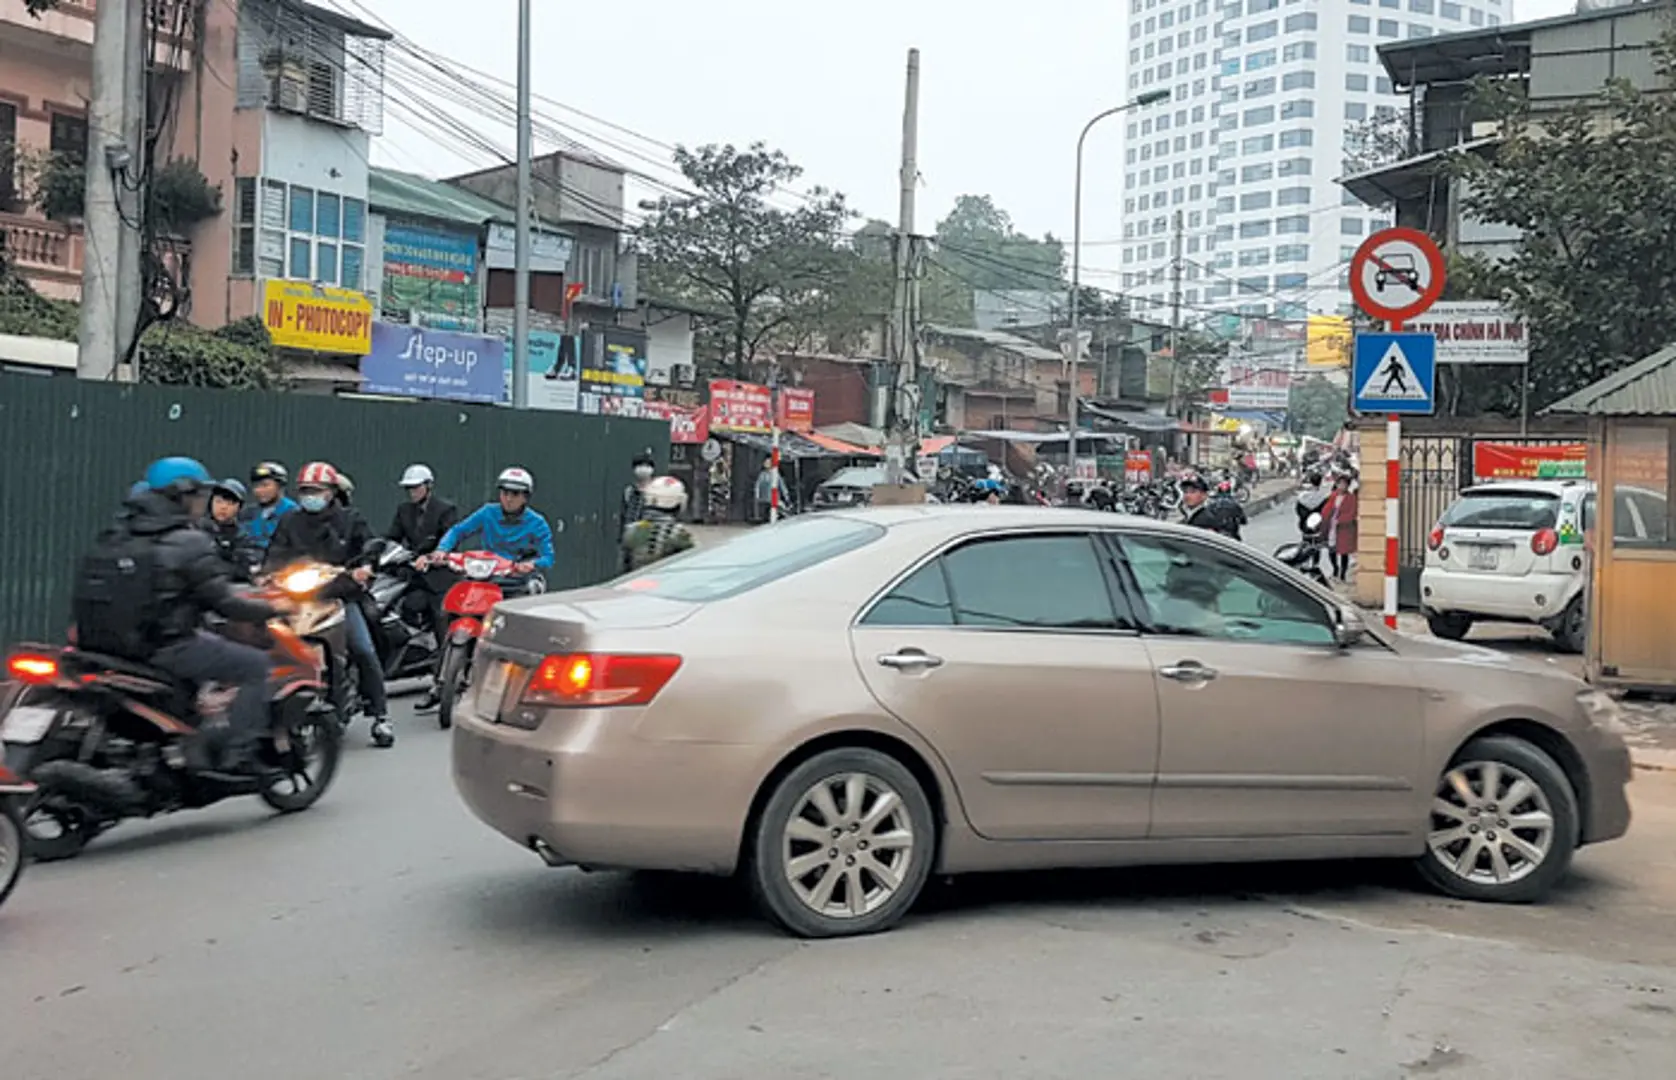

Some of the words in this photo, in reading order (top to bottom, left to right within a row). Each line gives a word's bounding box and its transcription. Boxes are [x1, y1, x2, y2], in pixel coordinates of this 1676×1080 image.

[268, 299, 284, 329] IN
[296, 303, 370, 340] PHOTOCOPY
[1486, 319, 1502, 341] HÀ
[398, 333, 478, 373] Step-up
